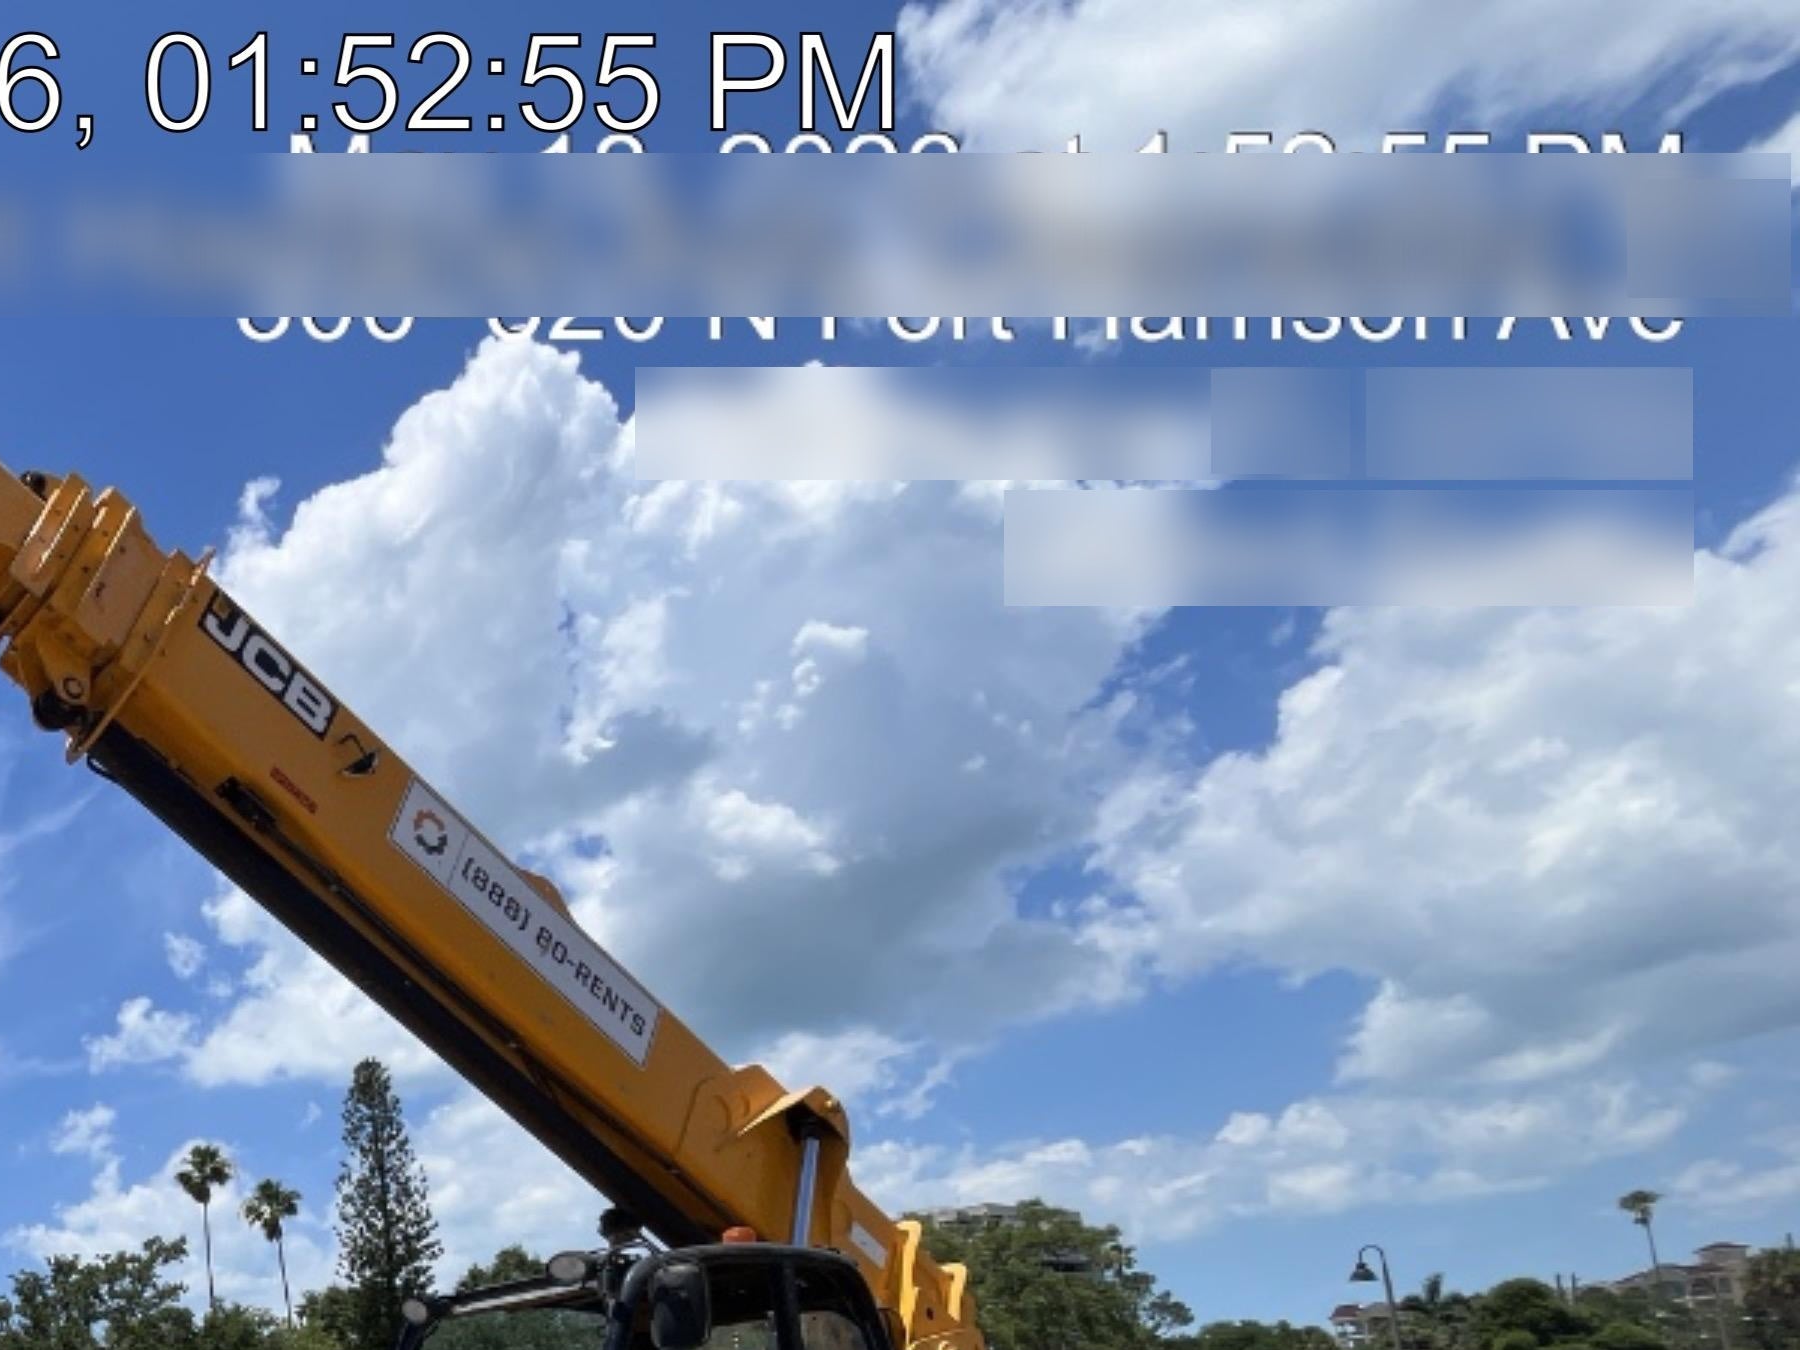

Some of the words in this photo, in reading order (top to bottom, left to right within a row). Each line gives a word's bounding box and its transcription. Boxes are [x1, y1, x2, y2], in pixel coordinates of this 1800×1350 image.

[204, 611, 335, 734] JCB
[461, 856, 532, 931] (888)
[535, 925, 647, 1037] 80-RENTS
